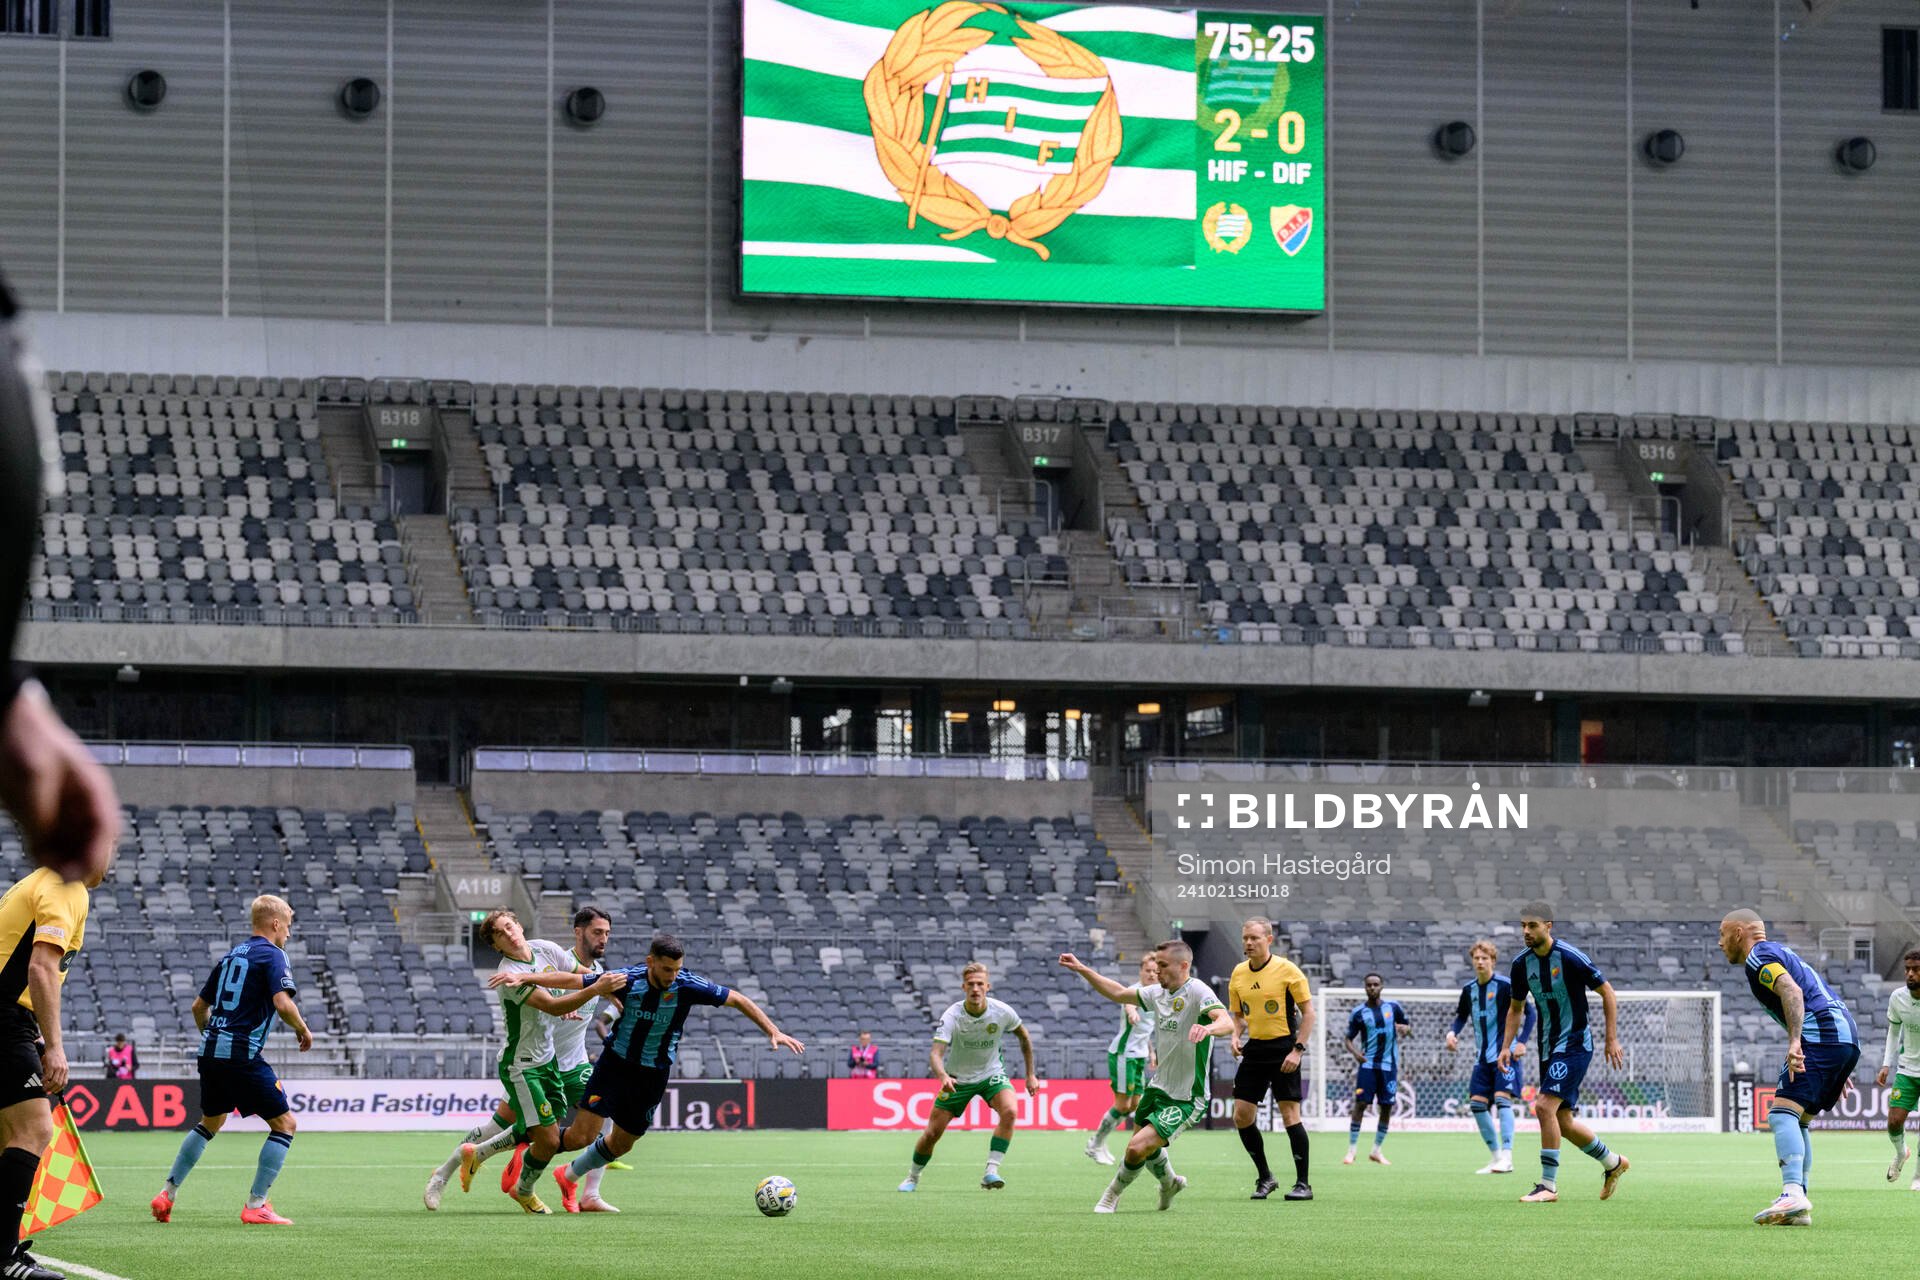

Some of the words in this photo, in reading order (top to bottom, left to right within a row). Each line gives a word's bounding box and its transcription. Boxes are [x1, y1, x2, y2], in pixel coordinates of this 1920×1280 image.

[1204, 22, 1315, 63] 75:25
[1214, 108, 1242, 152] 2
[1278, 111, 1305, 154] 0
[1207, 159, 1248, 182] HIF
[1272, 162, 1312, 184] DIF
[381, 410, 420, 426] B318
[1023, 427, 1061, 443] B317
[1640, 444, 1676, 460] B316
[456, 878, 502, 895] A118
[214, 956, 249, 1011] 19
[104, 1084, 187, 1128] AB
[289, 1093, 365, 1113] Stena
[872, 1080, 1079, 1127] Scndic
[1737, 1080, 1754, 1132] SELECT
